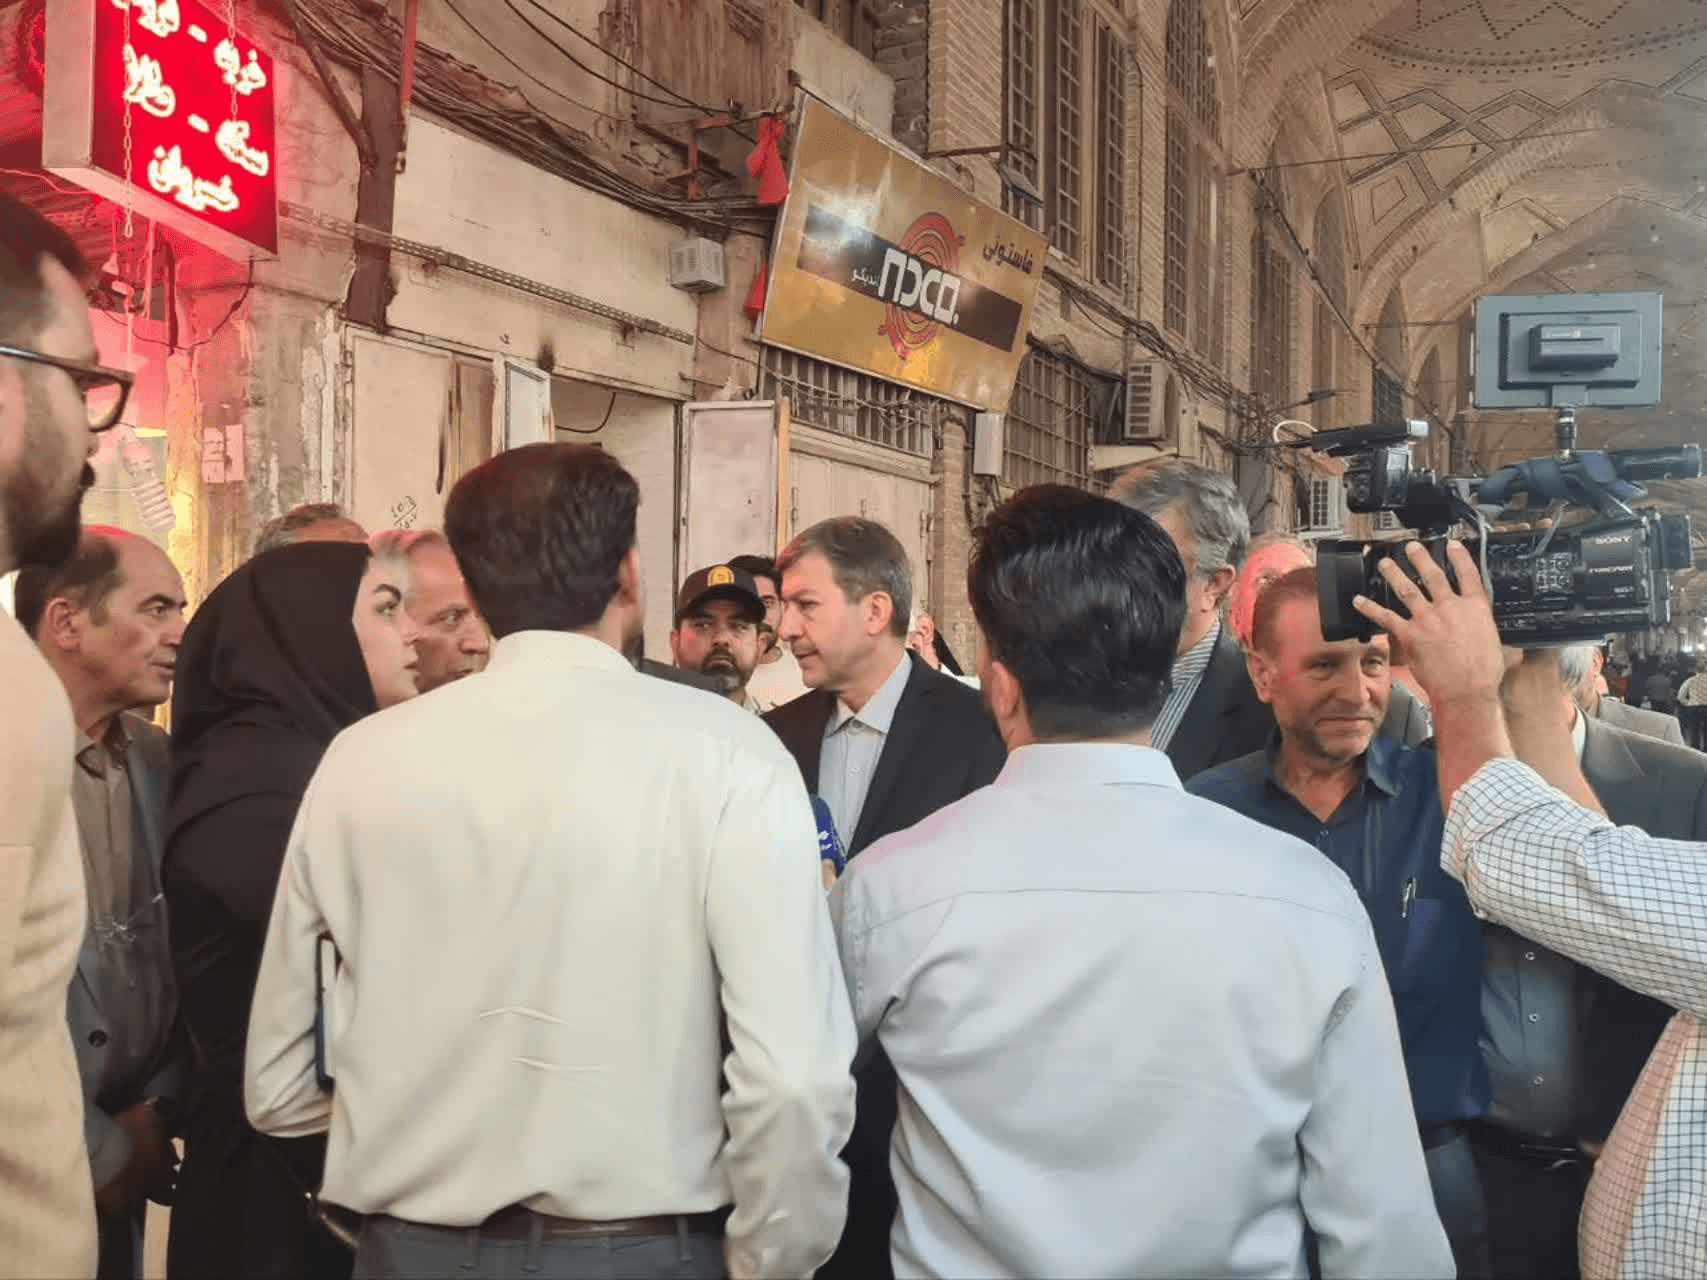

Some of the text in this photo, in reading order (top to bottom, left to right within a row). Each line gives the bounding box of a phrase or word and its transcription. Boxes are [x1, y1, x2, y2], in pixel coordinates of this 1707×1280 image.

[122, 43, 176, 117] طلا
[215, 119, 269, 176] سکه
[983, 235, 1033, 274] فاستونی
[1595, 535, 1632, 545] SONY
